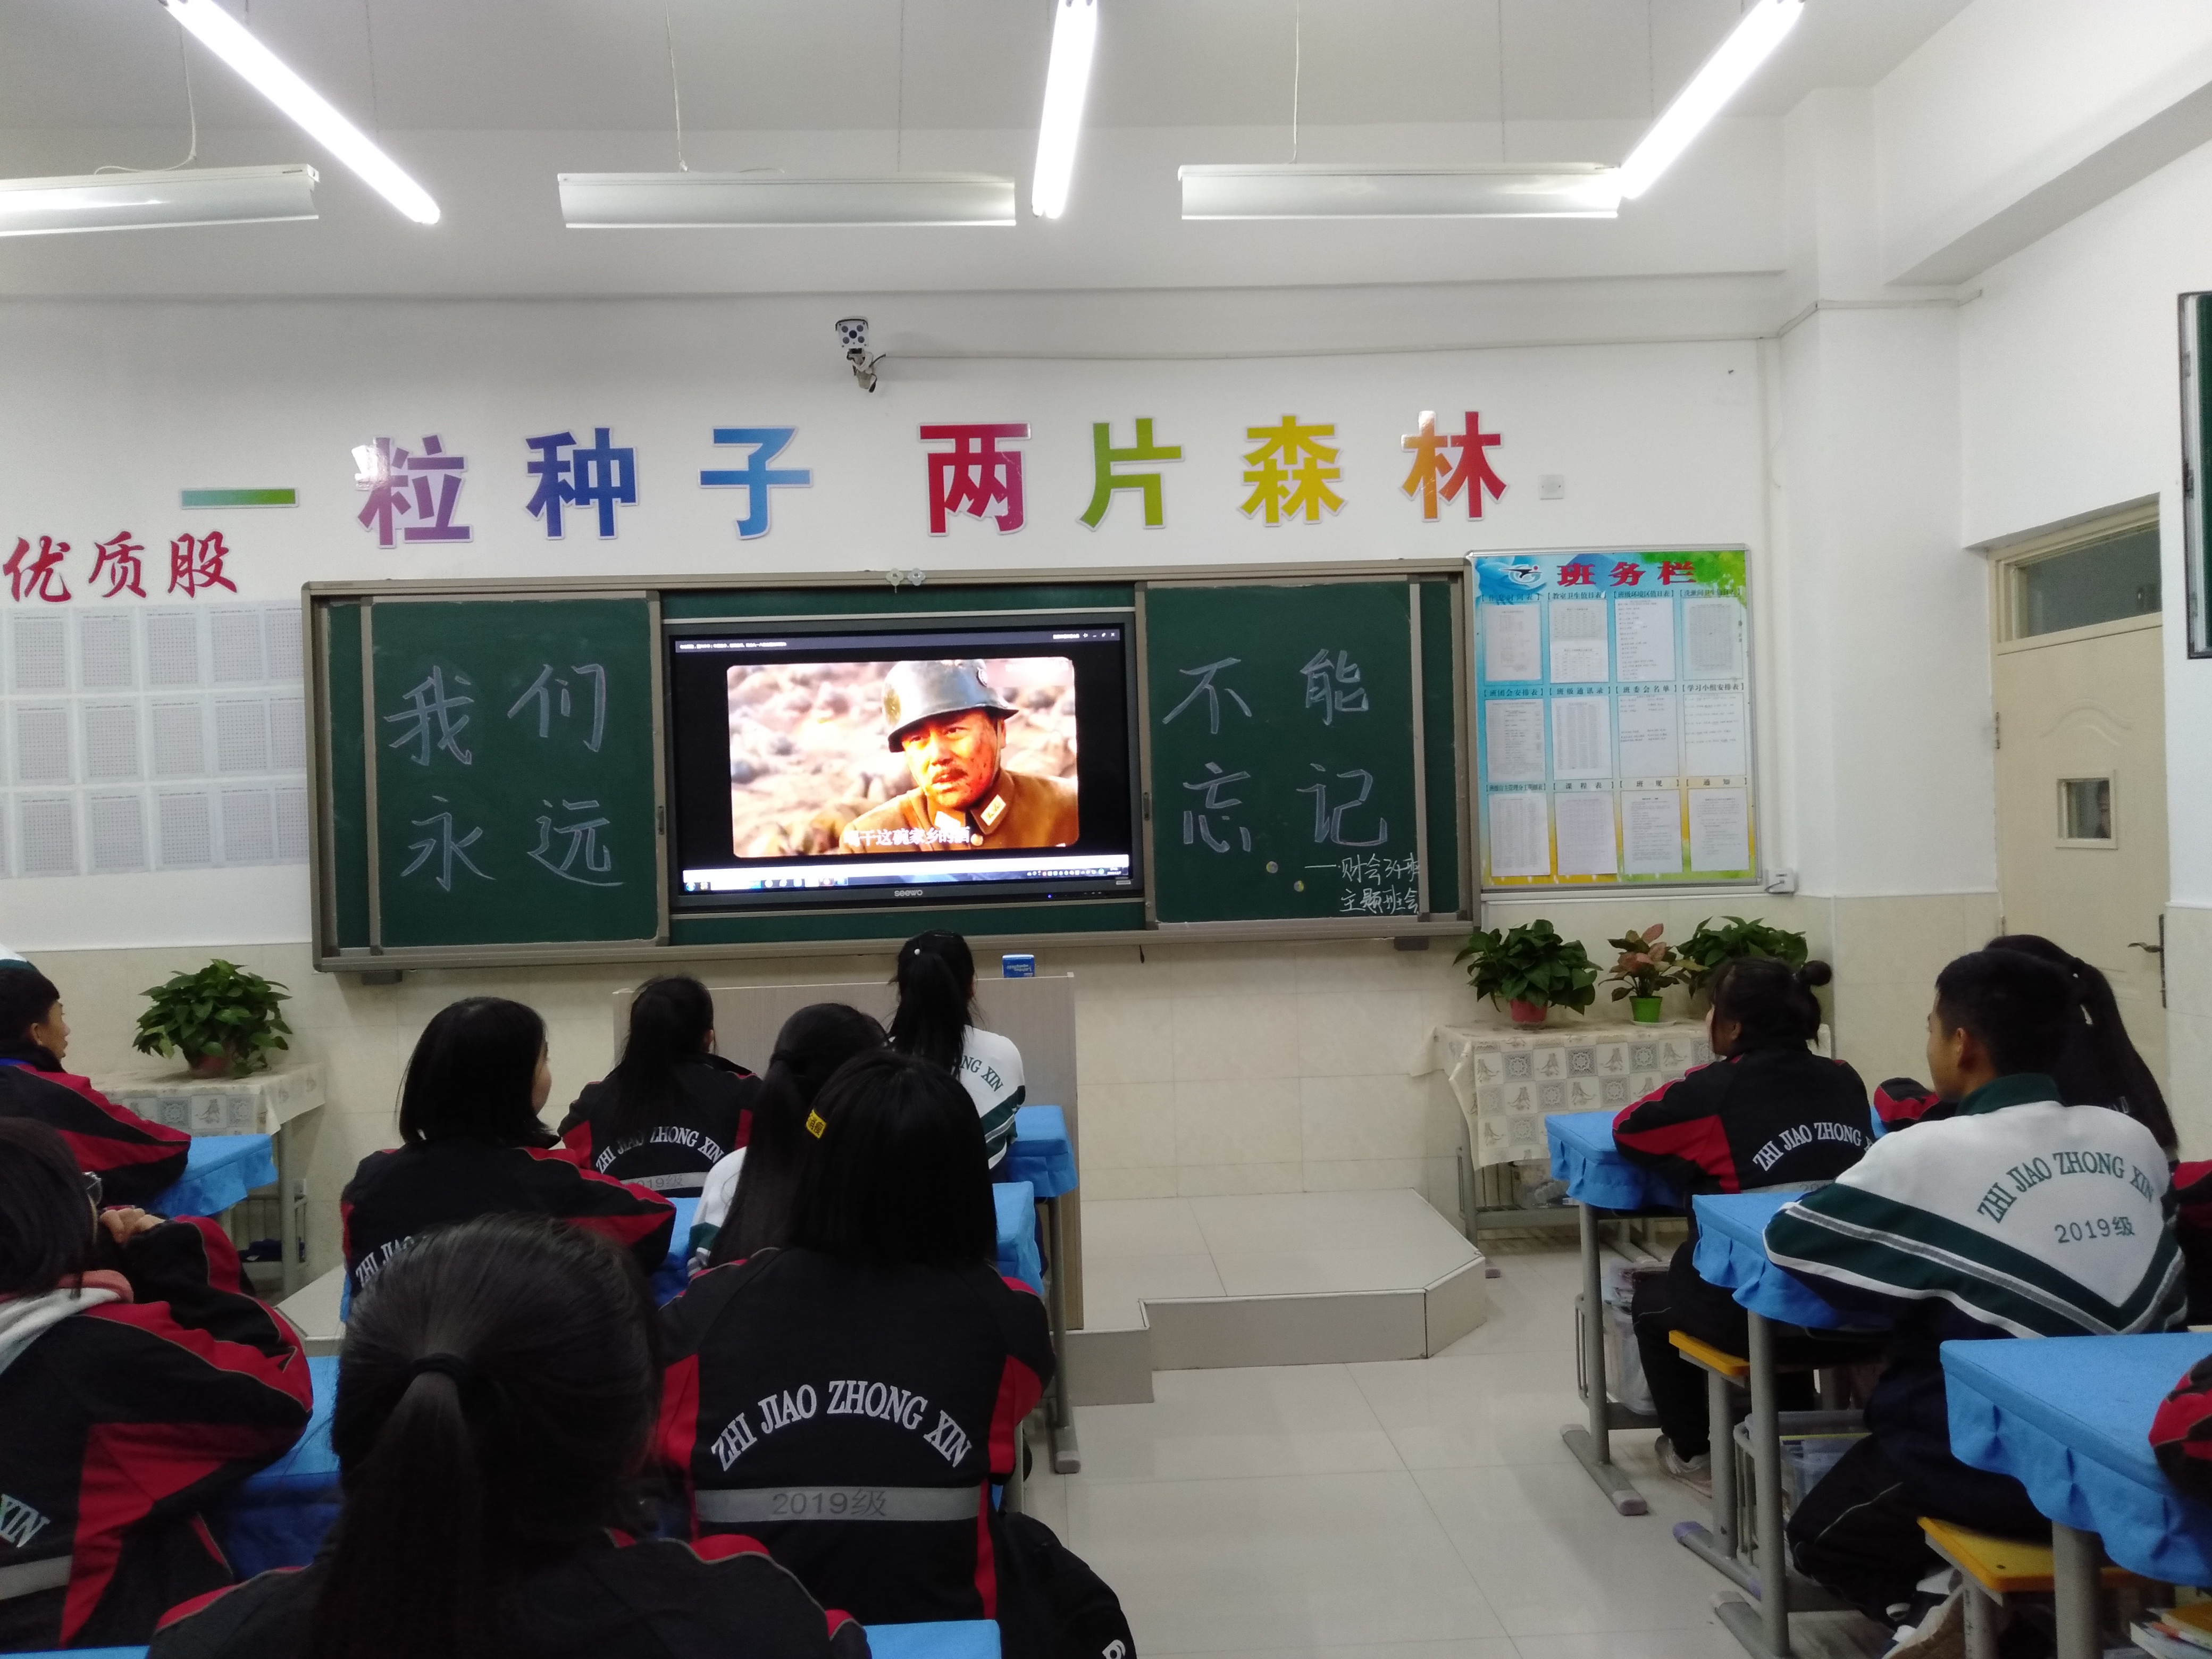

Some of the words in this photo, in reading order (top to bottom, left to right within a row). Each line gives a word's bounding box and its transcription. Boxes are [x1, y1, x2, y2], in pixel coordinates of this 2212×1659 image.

[181, 427, 812, 548] 一粒种子
[919, 411, 1508, 534] 两片森林
[3, 531, 238, 602] 优质股
[1557, 561, 1696, 587] 班务栏
[383, 663, 607, 766] 我们
[1162, 648, 1370, 734] 不能
[1183, 762, 1388, 853] 忘记
[400, 795, 626, 892] 永远
[1339, 884, 1419, 915] 主题班会
[981, 1066, 1004, 1092] XIN
[596, 1145, 617, 1174] ZHI
[650, 1126, 699, 1147] ZHONG
[697, 1136, 724, 1163] XIN
[1753, 1140, 1784, 1171] ZHI
[1778, 1124, 1813, 1151] JIAO
[1814, 1122, 1862, 1146] ZHONG
[1977, 1182, 2017, 1224] ZHI
[2006, 1157, 2052, 1193] JIAO
[2052, 1151, 2125, 1178] ZHONG
[2130, 1165, 2154, 1203] XIN
[2055, 1217, 2135, 1244] 2019级
[711, 1412, 757, 1472] ZHI
[757, 1384, 818, 1435] JIAO
[827, 1380, 928, 1430] ZHONG
[923, 1410, 973, 1469] XIN
[772, 1490, 887, 1519] 2019级
